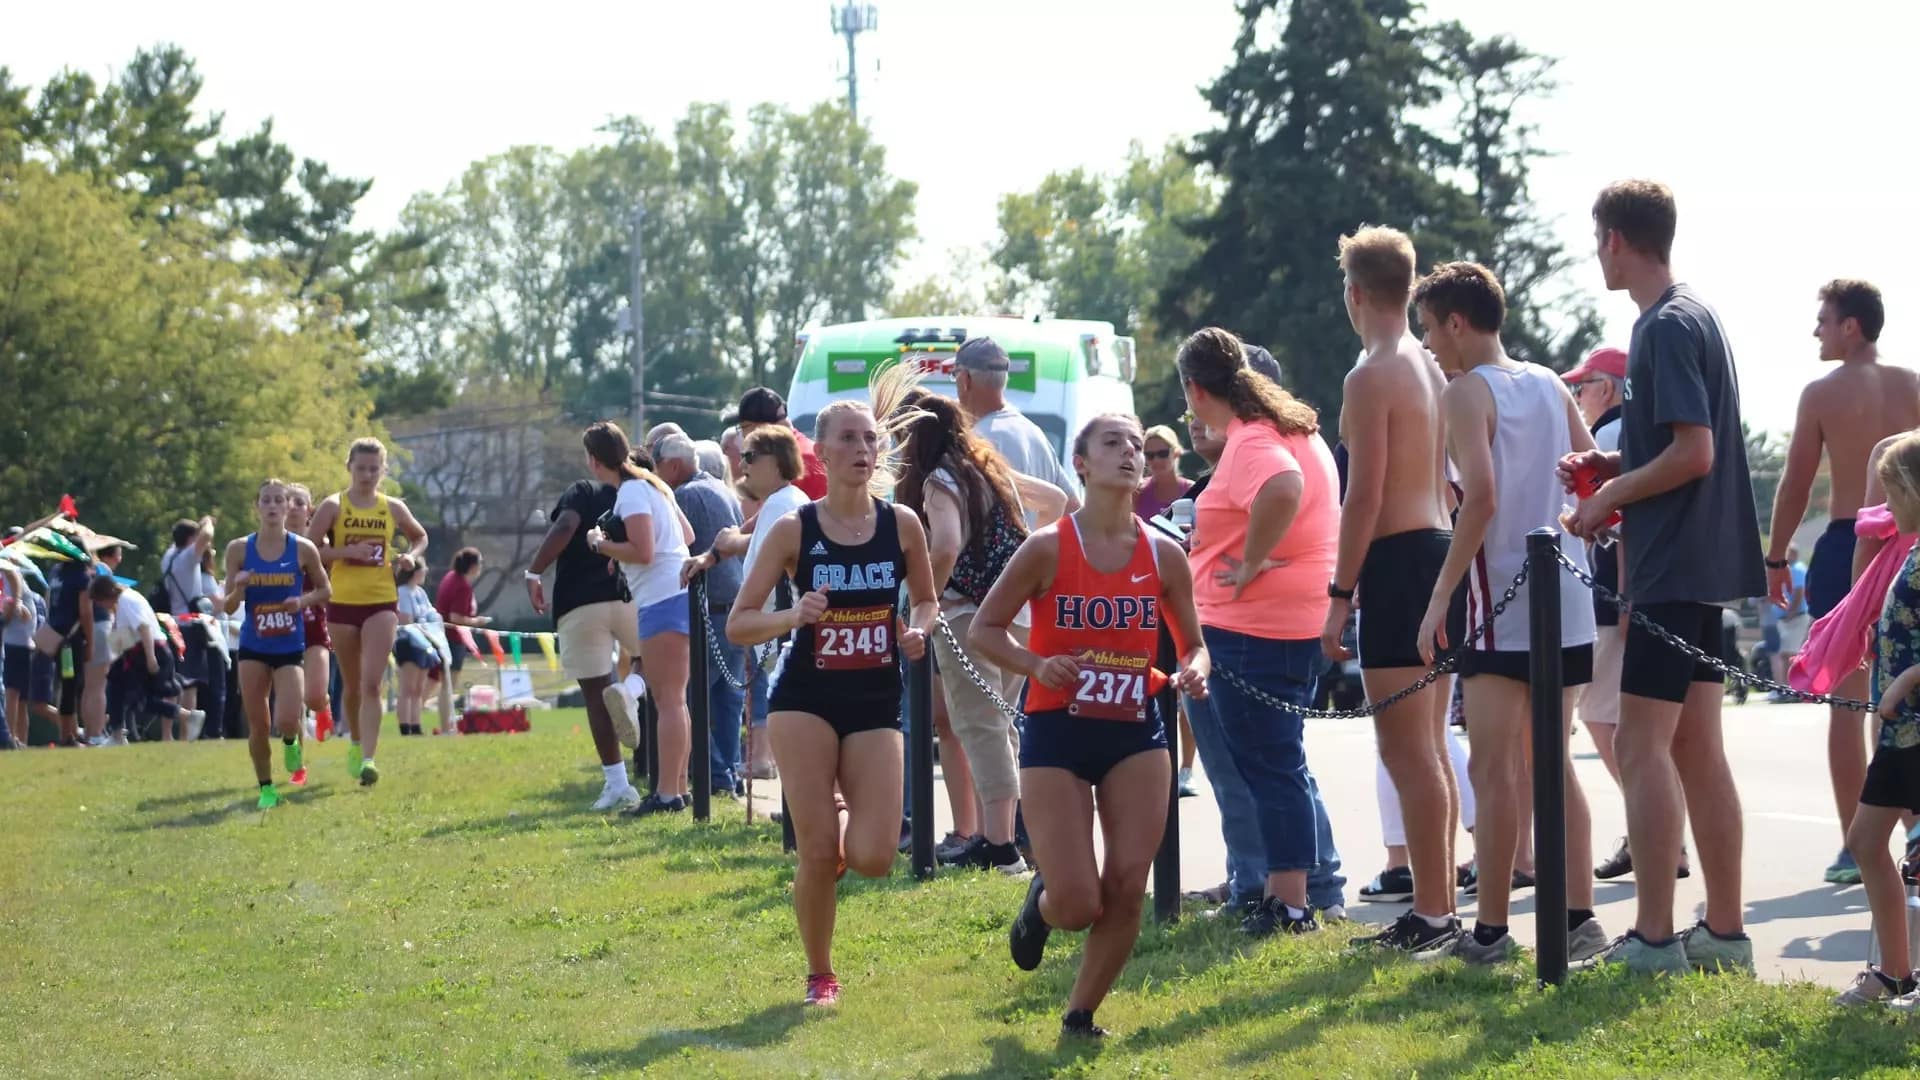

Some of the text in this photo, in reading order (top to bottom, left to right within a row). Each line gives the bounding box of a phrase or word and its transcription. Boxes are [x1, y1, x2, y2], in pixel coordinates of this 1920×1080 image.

[344, 517, 386, 529] CALVIN
[249, 572, 296, 586] AYHAWKS
[813, 562, 895, 590] GRACE
[256, 612, 293, 630] 2485
[1055, 595, 1159, 629] HOPE
[820, 625, 887, 656] 2349
[1075, 670, 1144, 705] 2374
